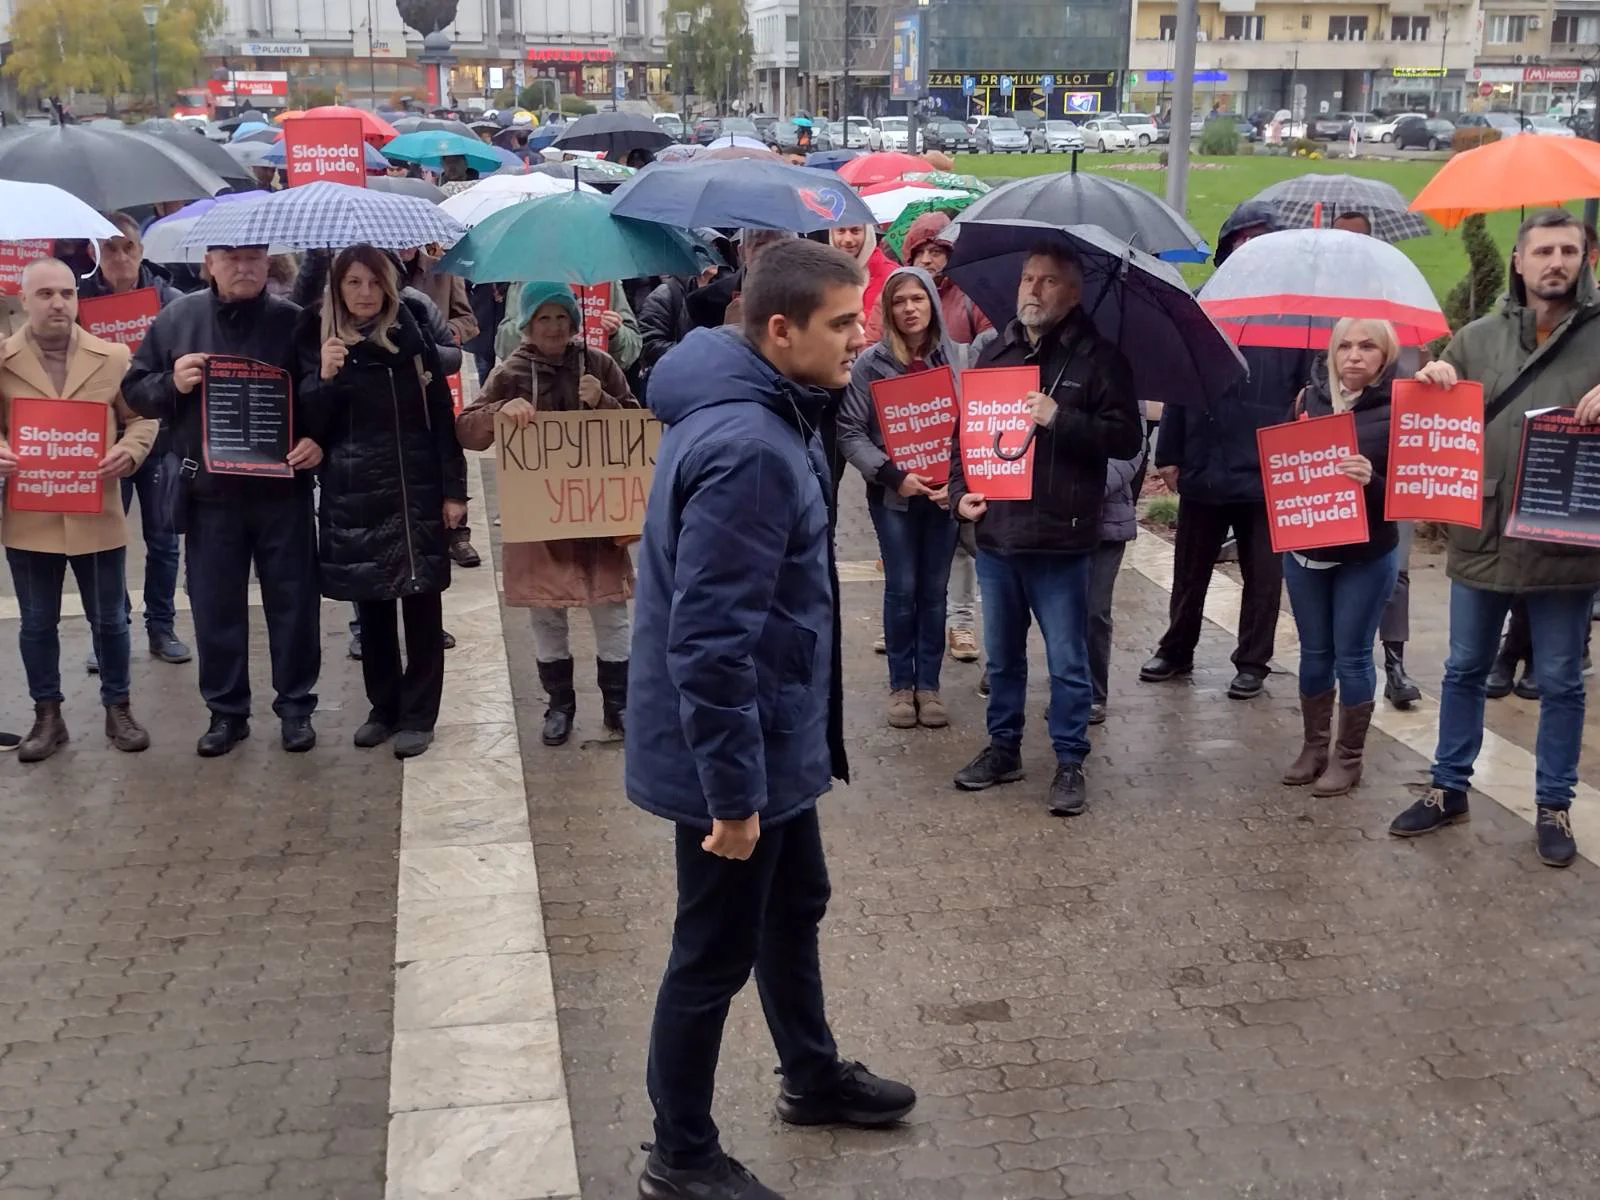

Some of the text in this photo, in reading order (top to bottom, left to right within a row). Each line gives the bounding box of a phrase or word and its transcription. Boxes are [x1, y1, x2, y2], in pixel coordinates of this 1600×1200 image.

[981, 75, 1045, 85] PRMIUM
[1056, 74, 1090, 84] SLOT
[292, 144, 359, 158] Sloboda
[294, 158, 360, 176] za ljude,
[0, 248, 14, 256] za
[884, 396, 952, 420] Sloboda
[888, 412, 956, 434] za ljude,
[966, 416, 1030, 436] za ljude,
[1399, 413, 1481, 434] Sloboda
[19, 426, 100, 442] Sloboda
[1398, 430, 1480, 454] za ljude,
[19, 442, 99, 460] za ljude,
[893, 439, 940, 456] zatvor
[1269, 444, 1350, 469] Sloboda
[896, 448, 951, 471] neljud
[968, 459, 1026, 480] neljude!
[18, 469, 97, 479] zatvor za
[1272, 461, 1344, 485] za ljude
[1396, 462, 1478, 481] zatvor za
[16, 480, 97, 497] neljude!
[1394, 478, 1478, 500] neljude!
[544, 476, 647, 524] УБИЈА
[1275, 490, 1356, 510] zatvor za
[1277, 502, 1358, 528] neljude!
